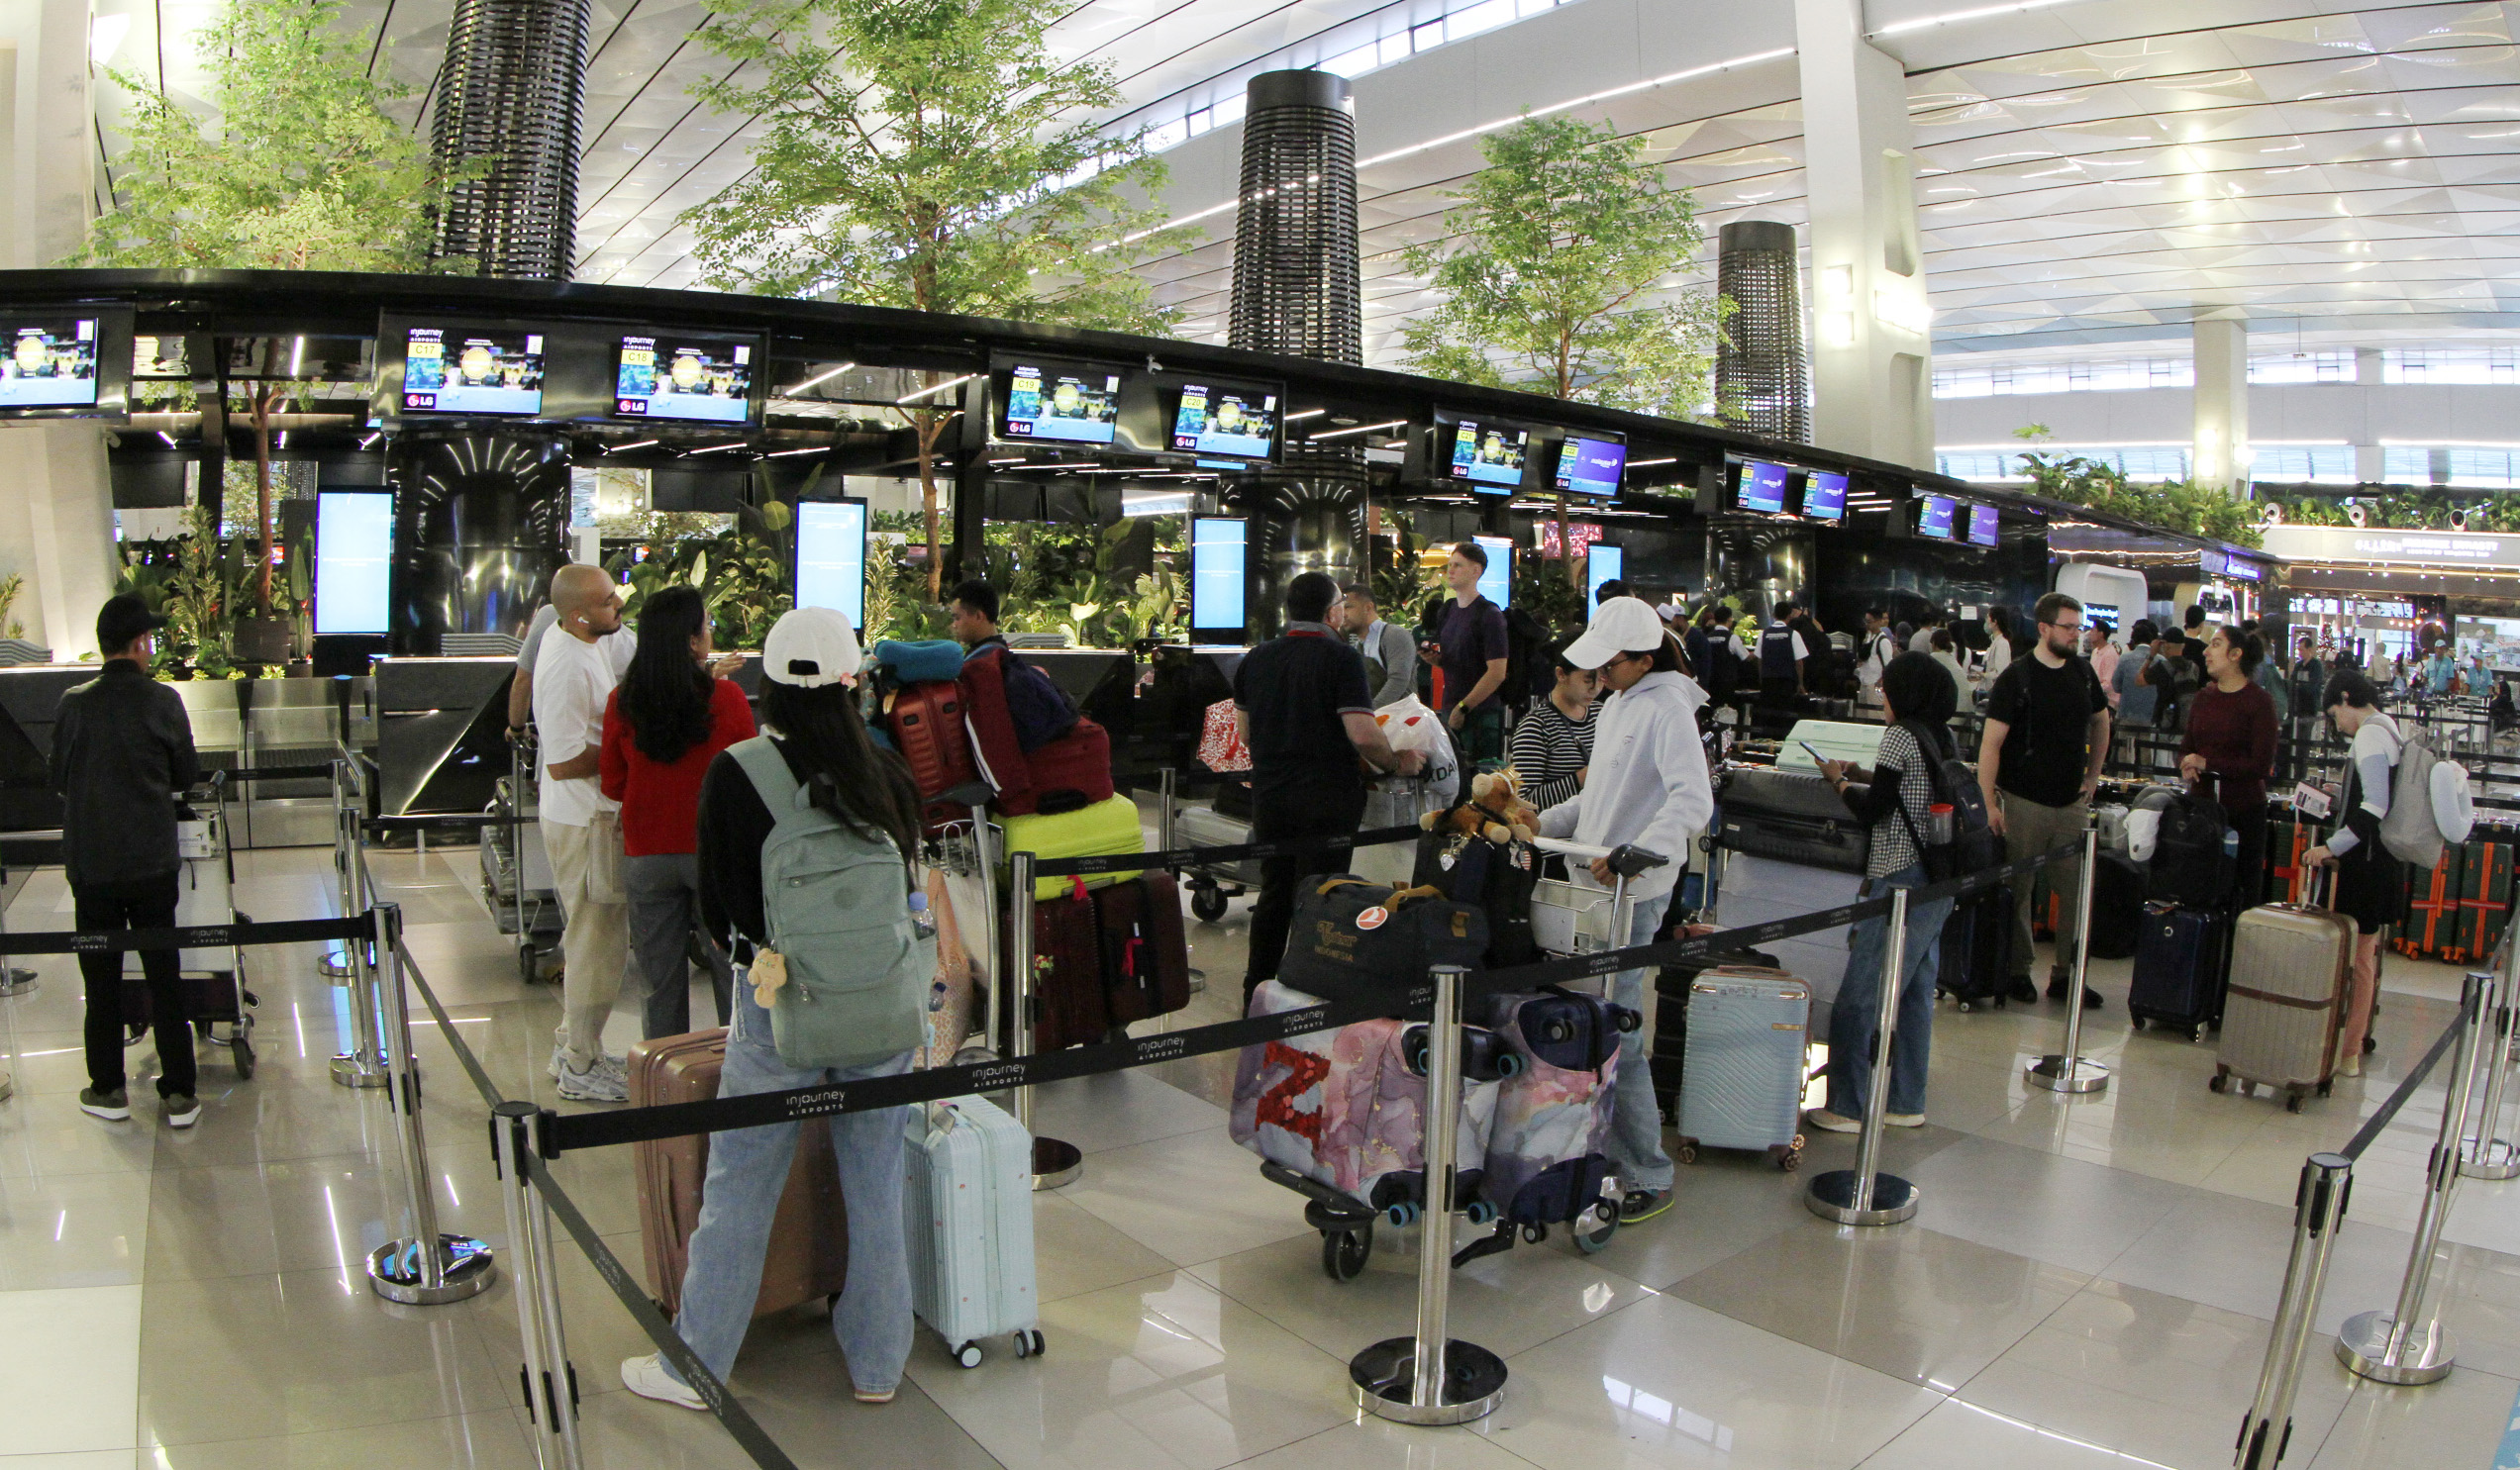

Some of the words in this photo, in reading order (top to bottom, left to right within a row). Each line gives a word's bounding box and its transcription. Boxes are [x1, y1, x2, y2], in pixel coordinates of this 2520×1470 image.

[410, 329, 444, 338] injourney
[623, 337, 655, 346] injourney
[416, 345, 435, 354] C17
[629, 352, 647, 362] C18
[1018, 380, 1035, 389] C19
[420, 396, 434, 406] LG
[1186, 398, 1201, 407] C20
[632, 402, 645, 411] LG
[1019, 424, 1031, 433] LG
[1185, 439, 1195, 447] LG
[191, 929, 228, 938] injourney
[70, 934, 107, 944] injourney
[1283, 1010, 1325, 1026] injourney
[1284, 1022, 1323, 1032] AIRPORTS
[1138, 1036, 1185, 1053] injourney
[1139, 1048, 1183, 1060] AIRPORTS
[972, 1063, 1026, 1080] injourney
[973, 1076, 1024, 1088] AIRPORTS
[786, 1090, 846, 1108] injourney
[788, 1103, 844, 1116] AIRPORTS
